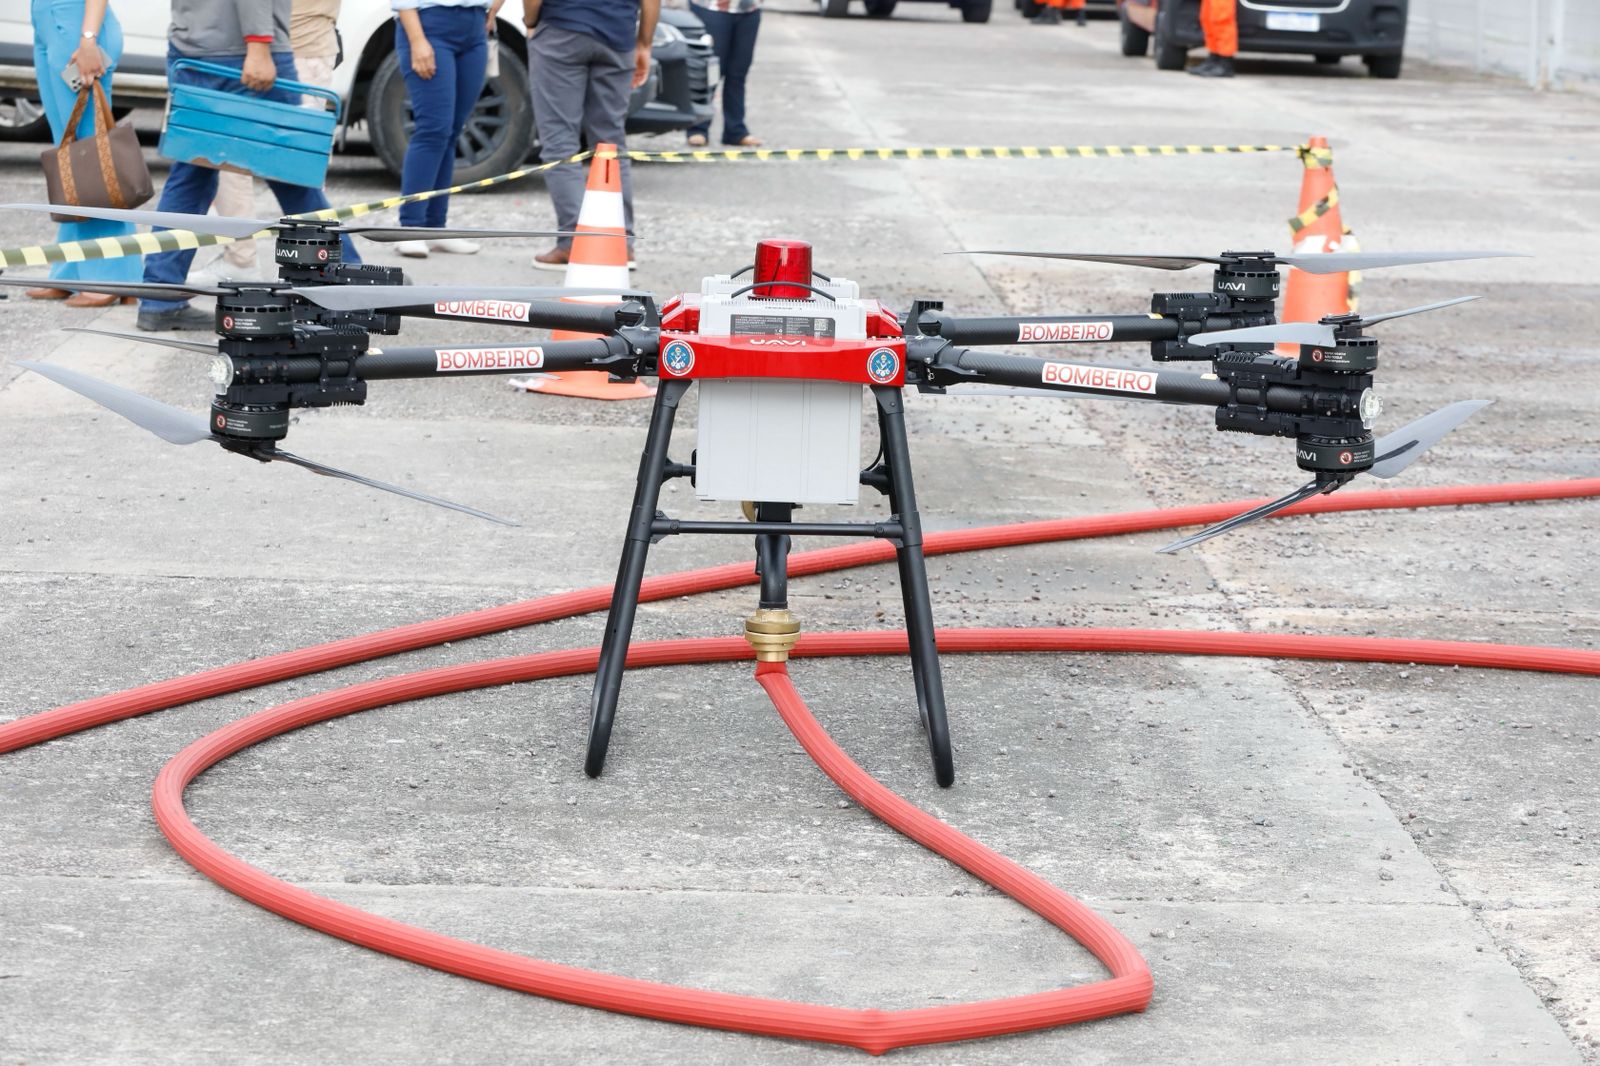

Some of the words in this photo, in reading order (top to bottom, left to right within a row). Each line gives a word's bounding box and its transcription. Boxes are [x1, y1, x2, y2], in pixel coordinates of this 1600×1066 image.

[1217, 281, 1246, 291] UAVI
[437, 301, 526, 320] BOMBEIRO
[1021, 324, 1110, 340] BOMBEIRO
[440, 349, 540, 369] BOMBEIRO
[1045, 364, 1152, 391] BOMBEIRO
